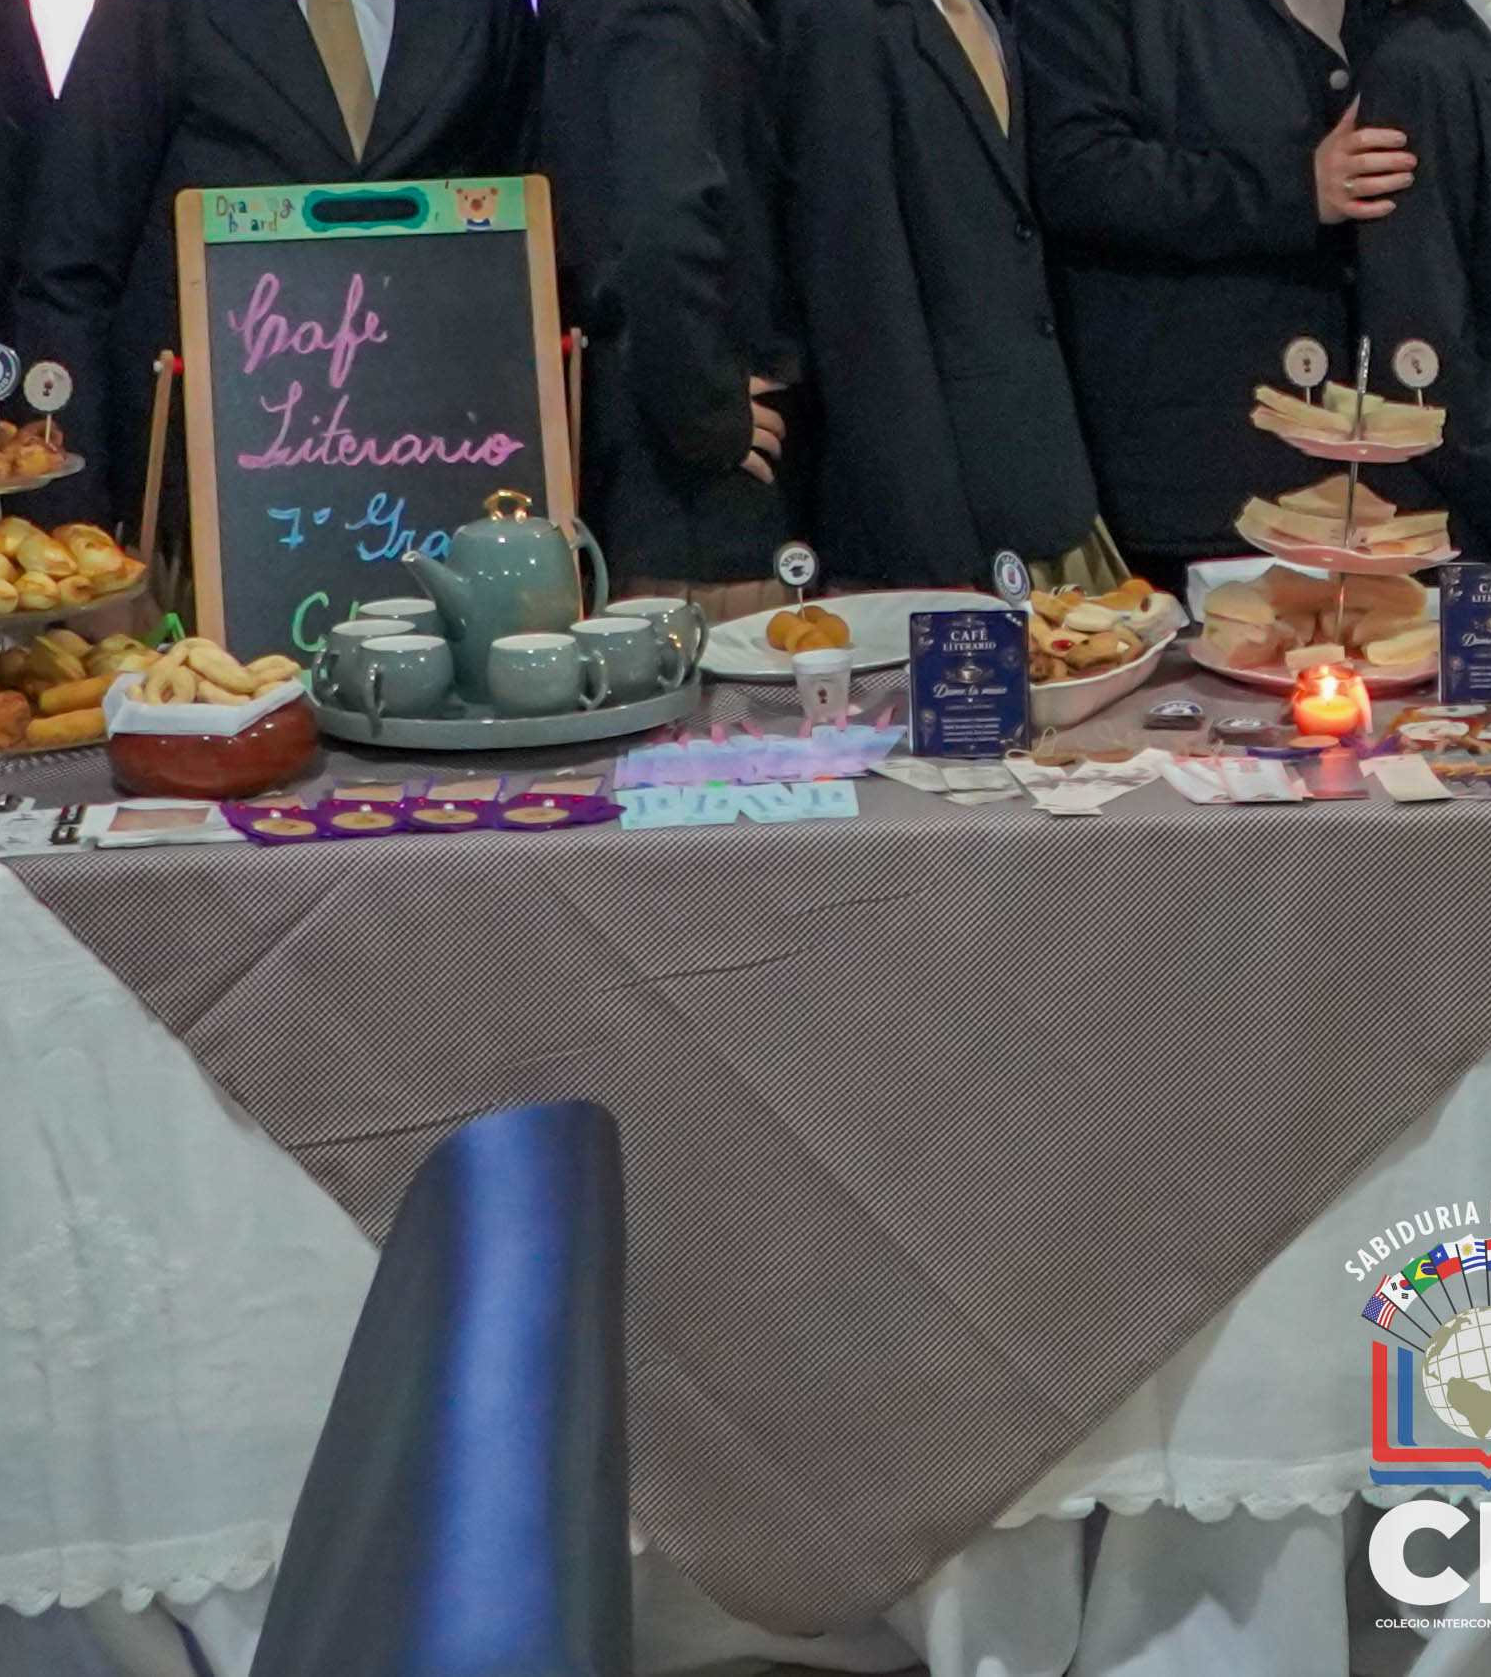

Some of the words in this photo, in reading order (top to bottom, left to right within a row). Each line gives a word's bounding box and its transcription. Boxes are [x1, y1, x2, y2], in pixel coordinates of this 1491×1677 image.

[237, 381, 525, 470] Literario
[346, 491, 453, 562] Gra
[950, 627, 988, 641] CAFÉ
